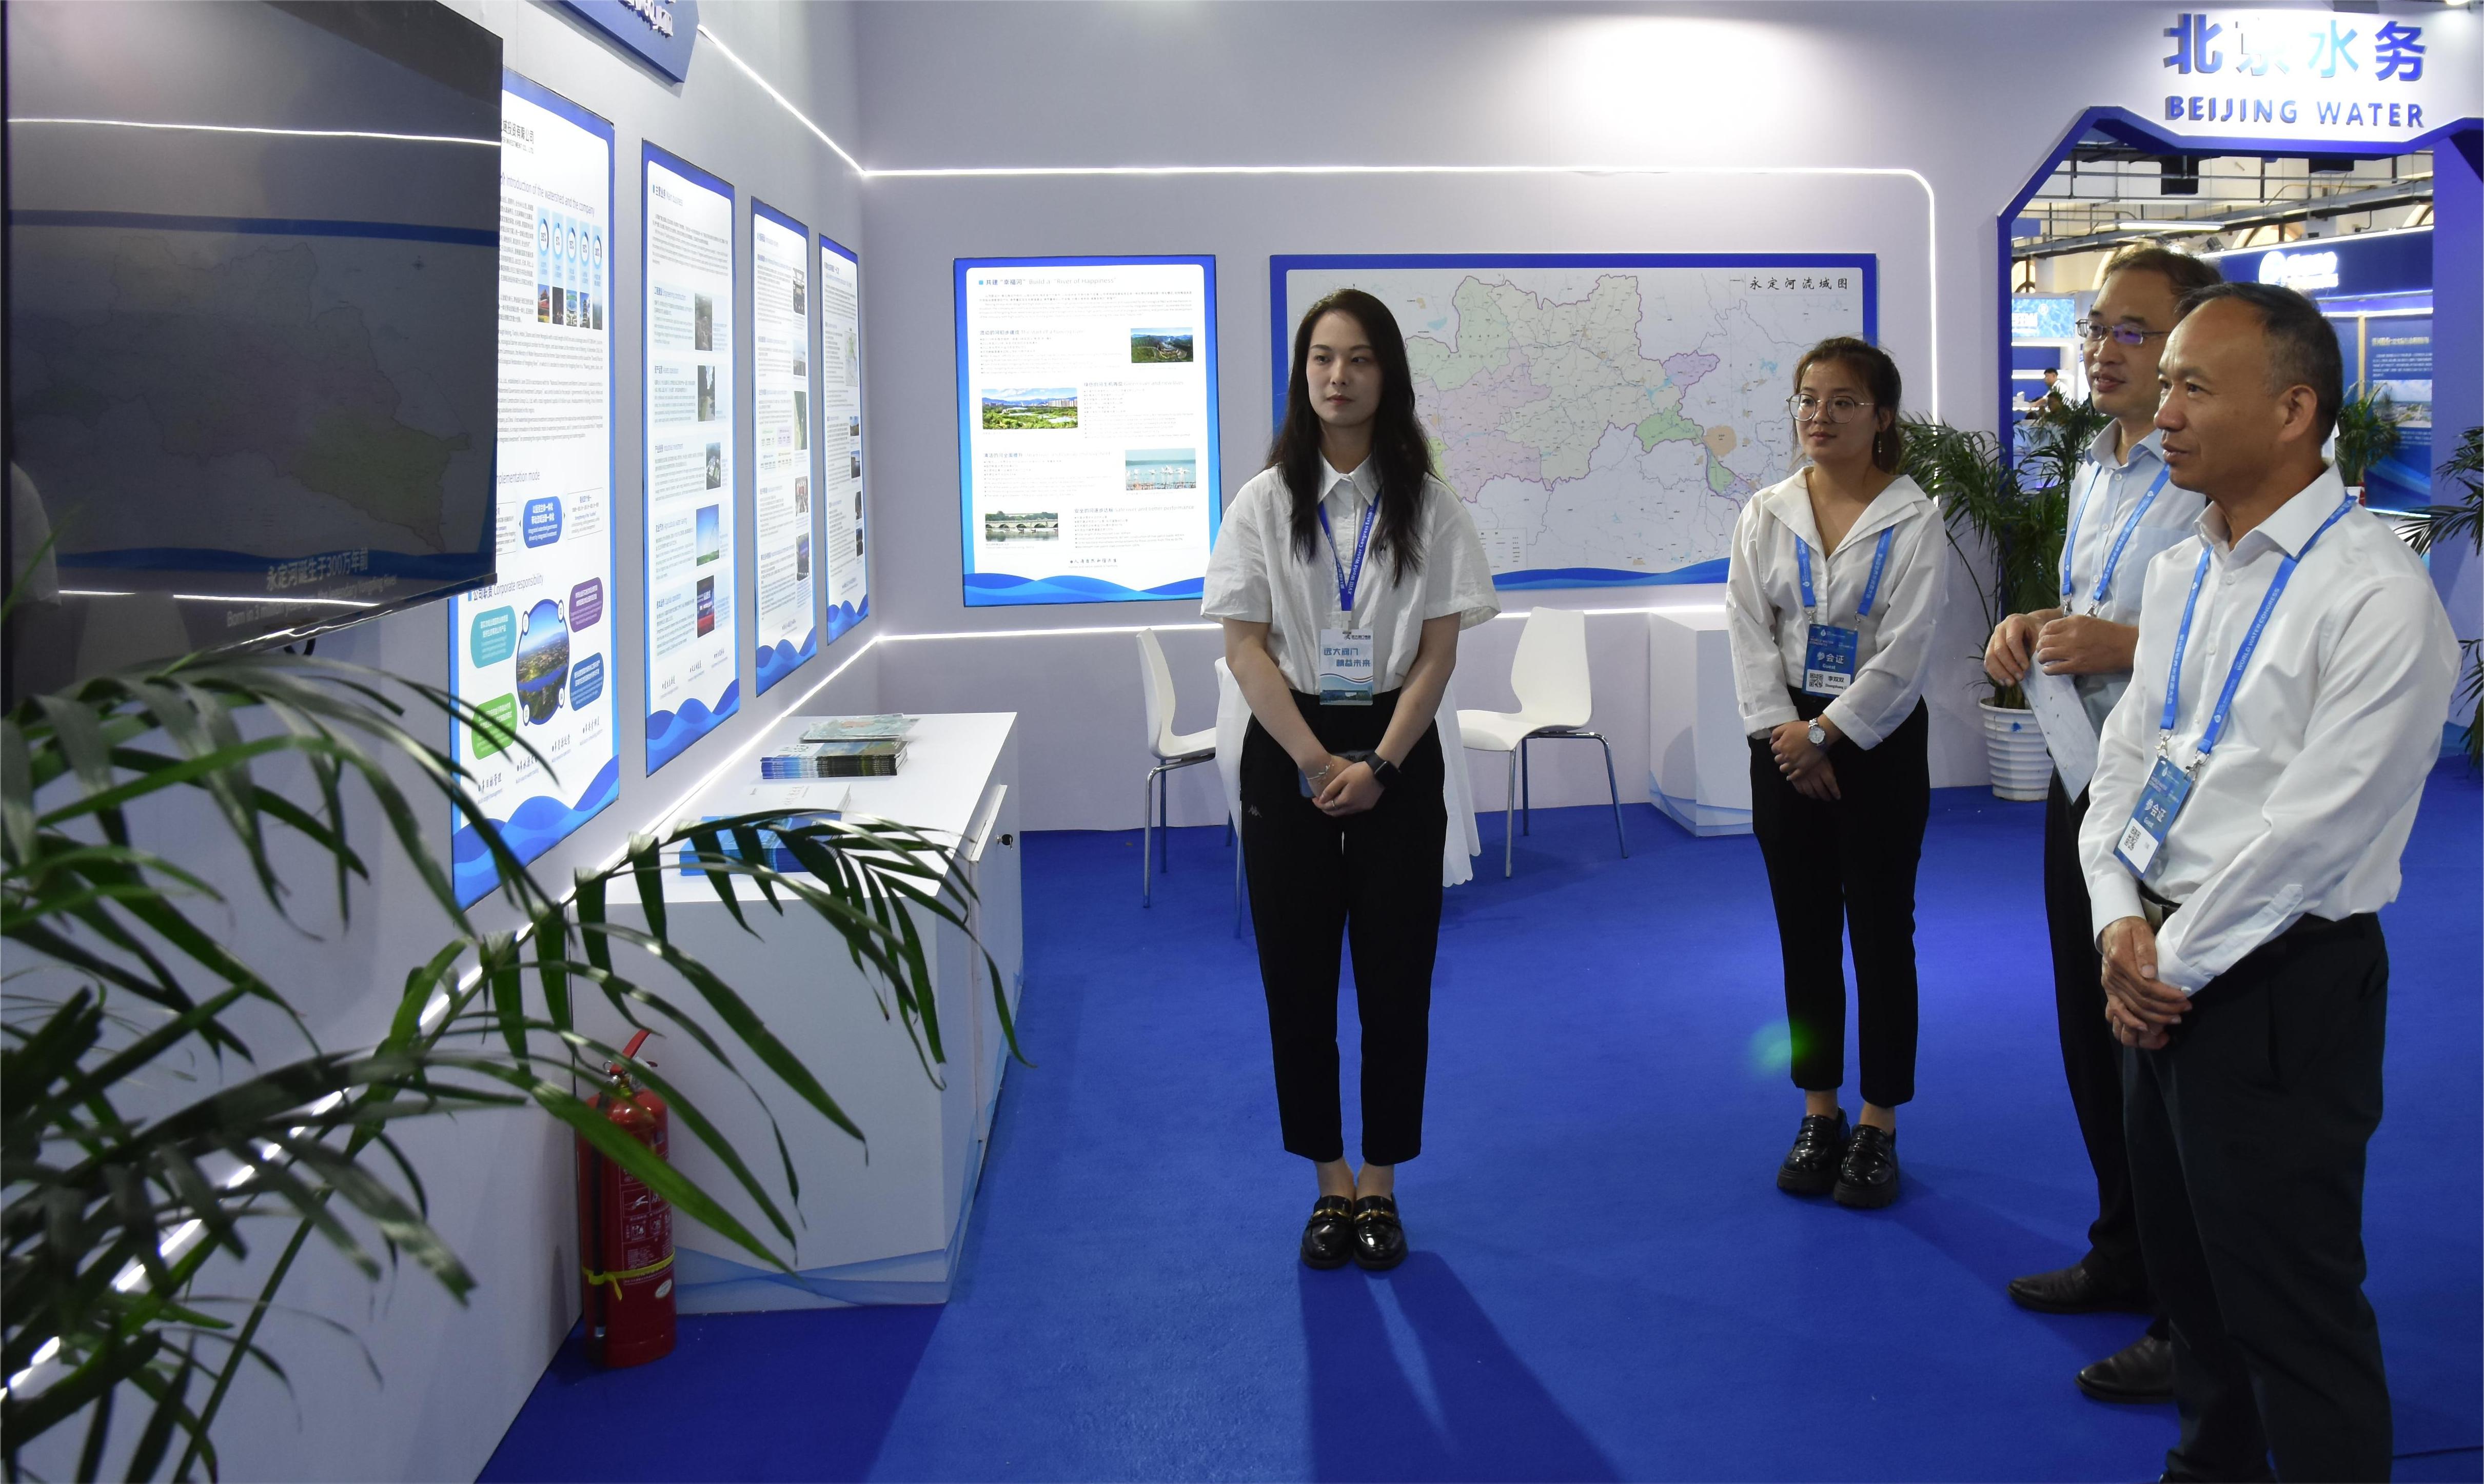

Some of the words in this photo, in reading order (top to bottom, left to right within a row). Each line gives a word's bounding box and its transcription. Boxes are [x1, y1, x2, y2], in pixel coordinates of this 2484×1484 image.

[2165, 95, 2297, 123] BEIJING
[2317, 101, 2424, 128] WATER
[1749, 276, 1848, 290] 永定河流域图
[1350, 565, 1358, 581] World
[1358, 526, 1369, 548] Congress
[266, 547, 369, 591] 永定河诞生于300万年前
[494, 580, 516, 597] Corporate
[516, 573, 544, 591] responsibility
[2237, 646, 2251, 671] WORLD
[2249, 623, 2261, 647] WATER
[2259, 588, 2280, 624] CONGRESS
[1817, 651, 1845, 664] 参会证
[2144, 798, 2167, 822] 参会证
